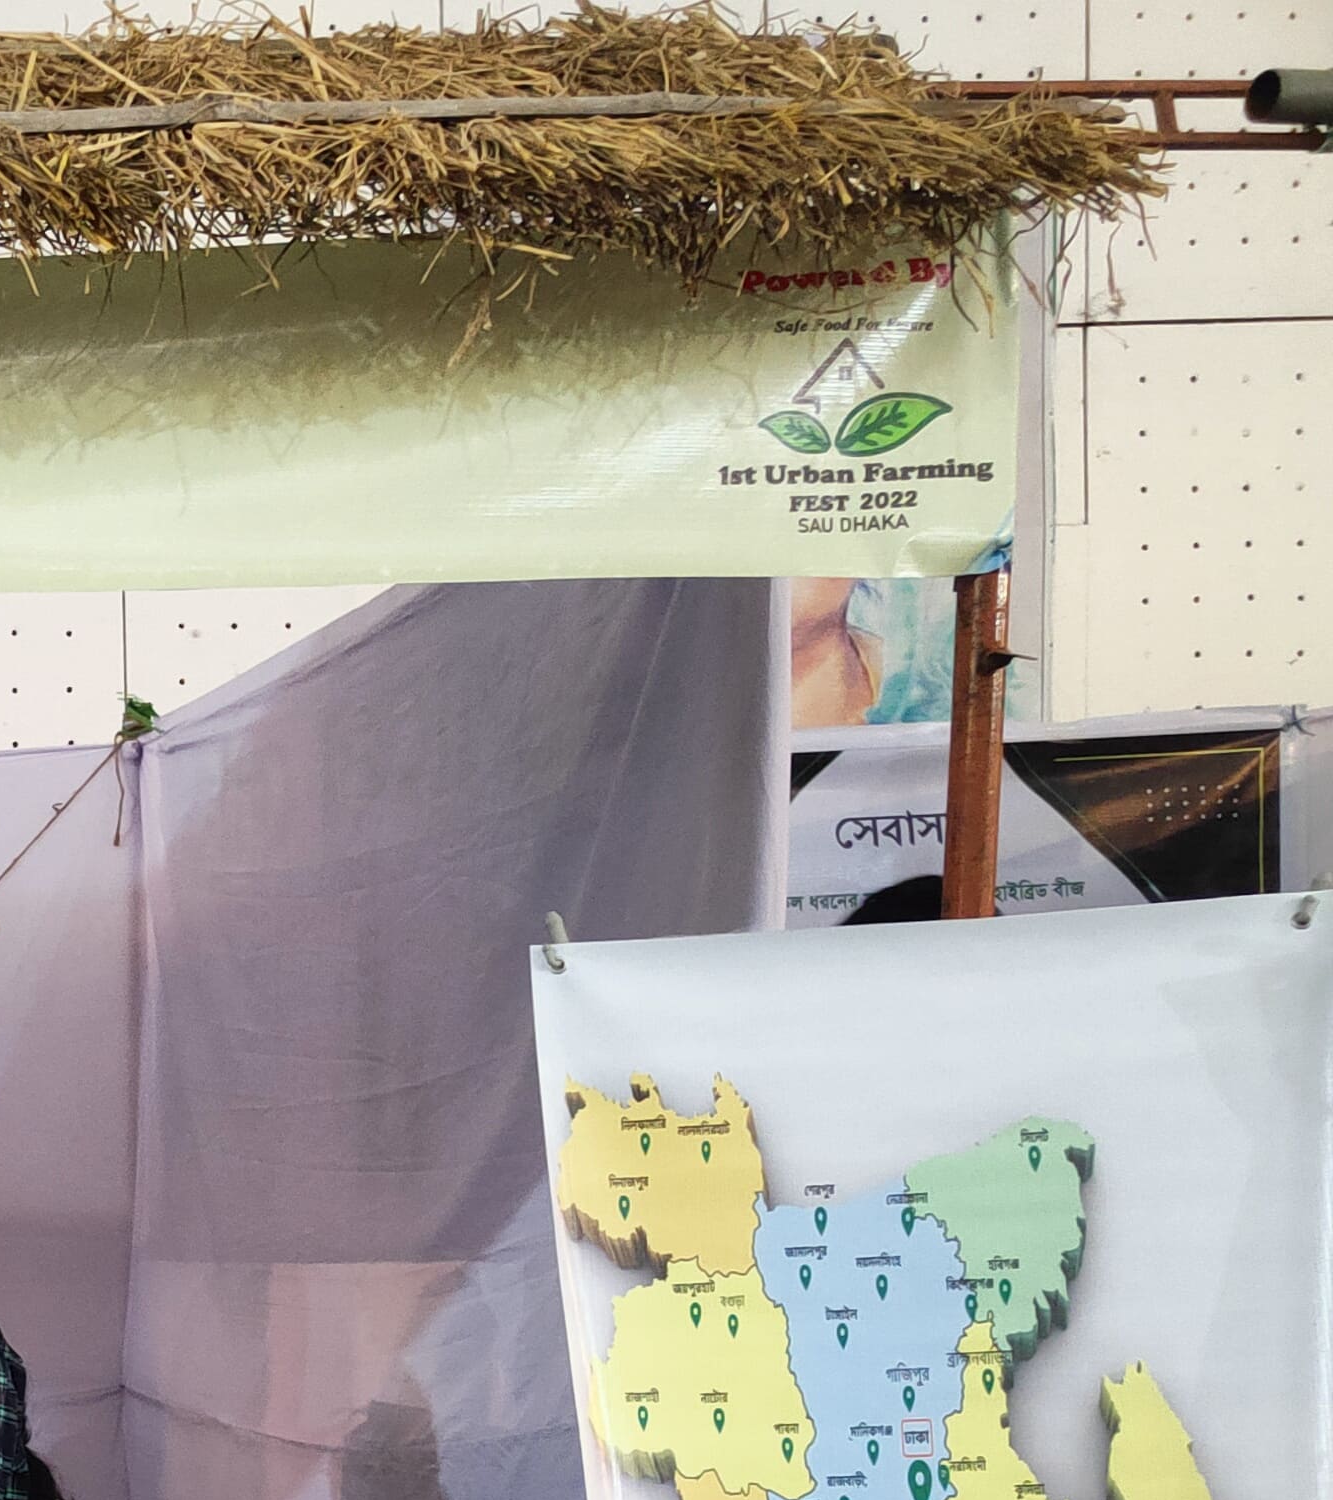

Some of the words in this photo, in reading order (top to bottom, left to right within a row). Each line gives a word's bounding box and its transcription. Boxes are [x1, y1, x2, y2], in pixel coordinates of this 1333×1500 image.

[774, 319, 809, 335] Safe
[812, 317, 851, 333] Food
[718, 465, 758, 486] 1st
[764, 463, 855, 484] Urban
[863, 458, 995, 484] Farming
[788, 495, 851, 513] FEST
[859, 490, 919, 510] 2022
[797, 516, 835, 533] SAU
[839, 513, 909, 533] DHAKA
[834, 811, 947, 851] সেবাস
[1052, 876, 1086, 899] বীজ
[808, 892, 859, 912] ধরনের
